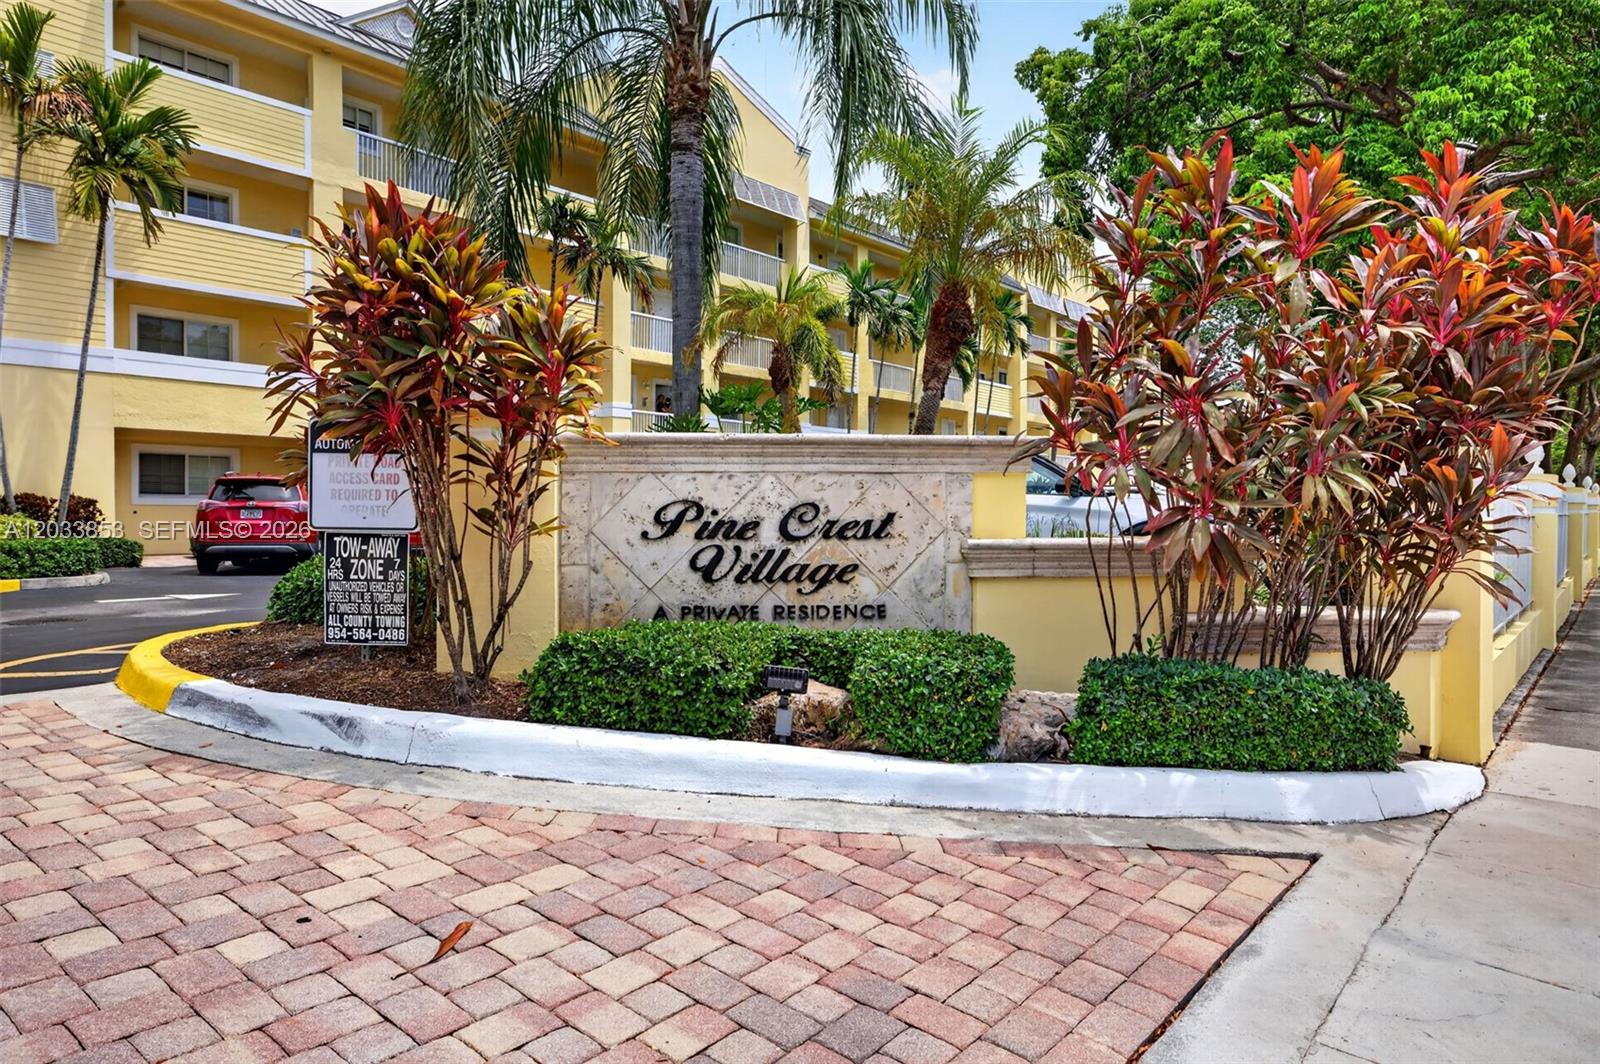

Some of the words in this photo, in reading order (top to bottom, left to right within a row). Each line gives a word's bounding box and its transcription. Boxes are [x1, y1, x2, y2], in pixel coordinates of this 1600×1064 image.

[376, 455, 402, 468] OAD
[329, 471, 369, 485] ACCESS
[373, 473, 400, 485] CARD
[331, 488, 381, 501] REQUIRED
[385, 489, 399, 501] TO
[641, 499, 760, 541] Pine
[778, 502, 898, 541] Crest
[333, 536, 401, 558] TOW-AWAY
[329, 557, 342, 569] 24
[350, 559, 384, 579] ZONE
[393, 559, 401, 569] 7
[327, 569, 344, 580] HRS
[388, 570, 406, 581] DAYS
[689, 544, 859, 596] Village
[328, 581, 368, 592] UNAUTHORIZED
[369, 582, 395, 592] VEHICLES
[396, 582, 405, 593] OR
[327, 592, 349, 602] VESSELS
[350, 592, 362, 602] WILL
[364, 592, 371, 603] BE
[373, 592, 391, 603] TOWED
[393, 593, 406, 603] AWAY
[329, 602, 335, 613] AT
[360, 603, 372, 614] RISK
[374, 604, 378, 614] &
[380, 604, 404, 614] EXPENSE
[653, 606, 669, 621] A
[681, 605, 759, 621] PRIVATE
[773, 604, 887, 621] RESIDENCE
[327, 614, 342, 627] ALL
[343, 614, 373, 627] COUNTY
[375, 615, 406, 628] TOWING
[327, 627, 406, 640] 954-564-0486
